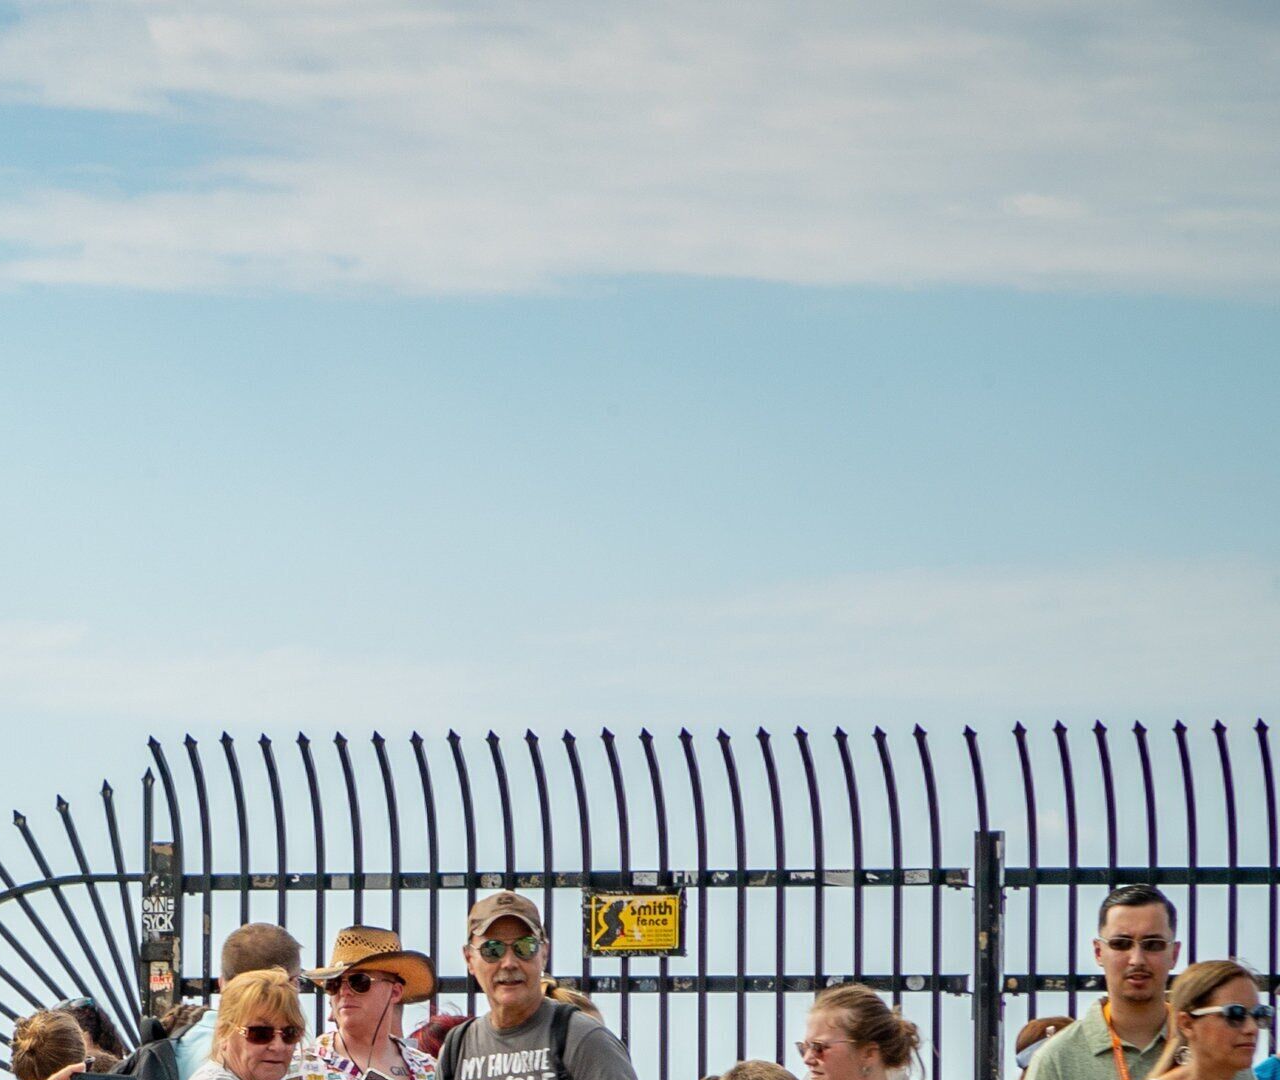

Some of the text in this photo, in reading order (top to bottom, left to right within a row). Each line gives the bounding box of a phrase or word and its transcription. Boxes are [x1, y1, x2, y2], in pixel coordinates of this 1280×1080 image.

[630, 901, 673, 916] smith
[636, 917, 668, 927] fence
[460, 1047, 551, 1080] MY FAVORITE
